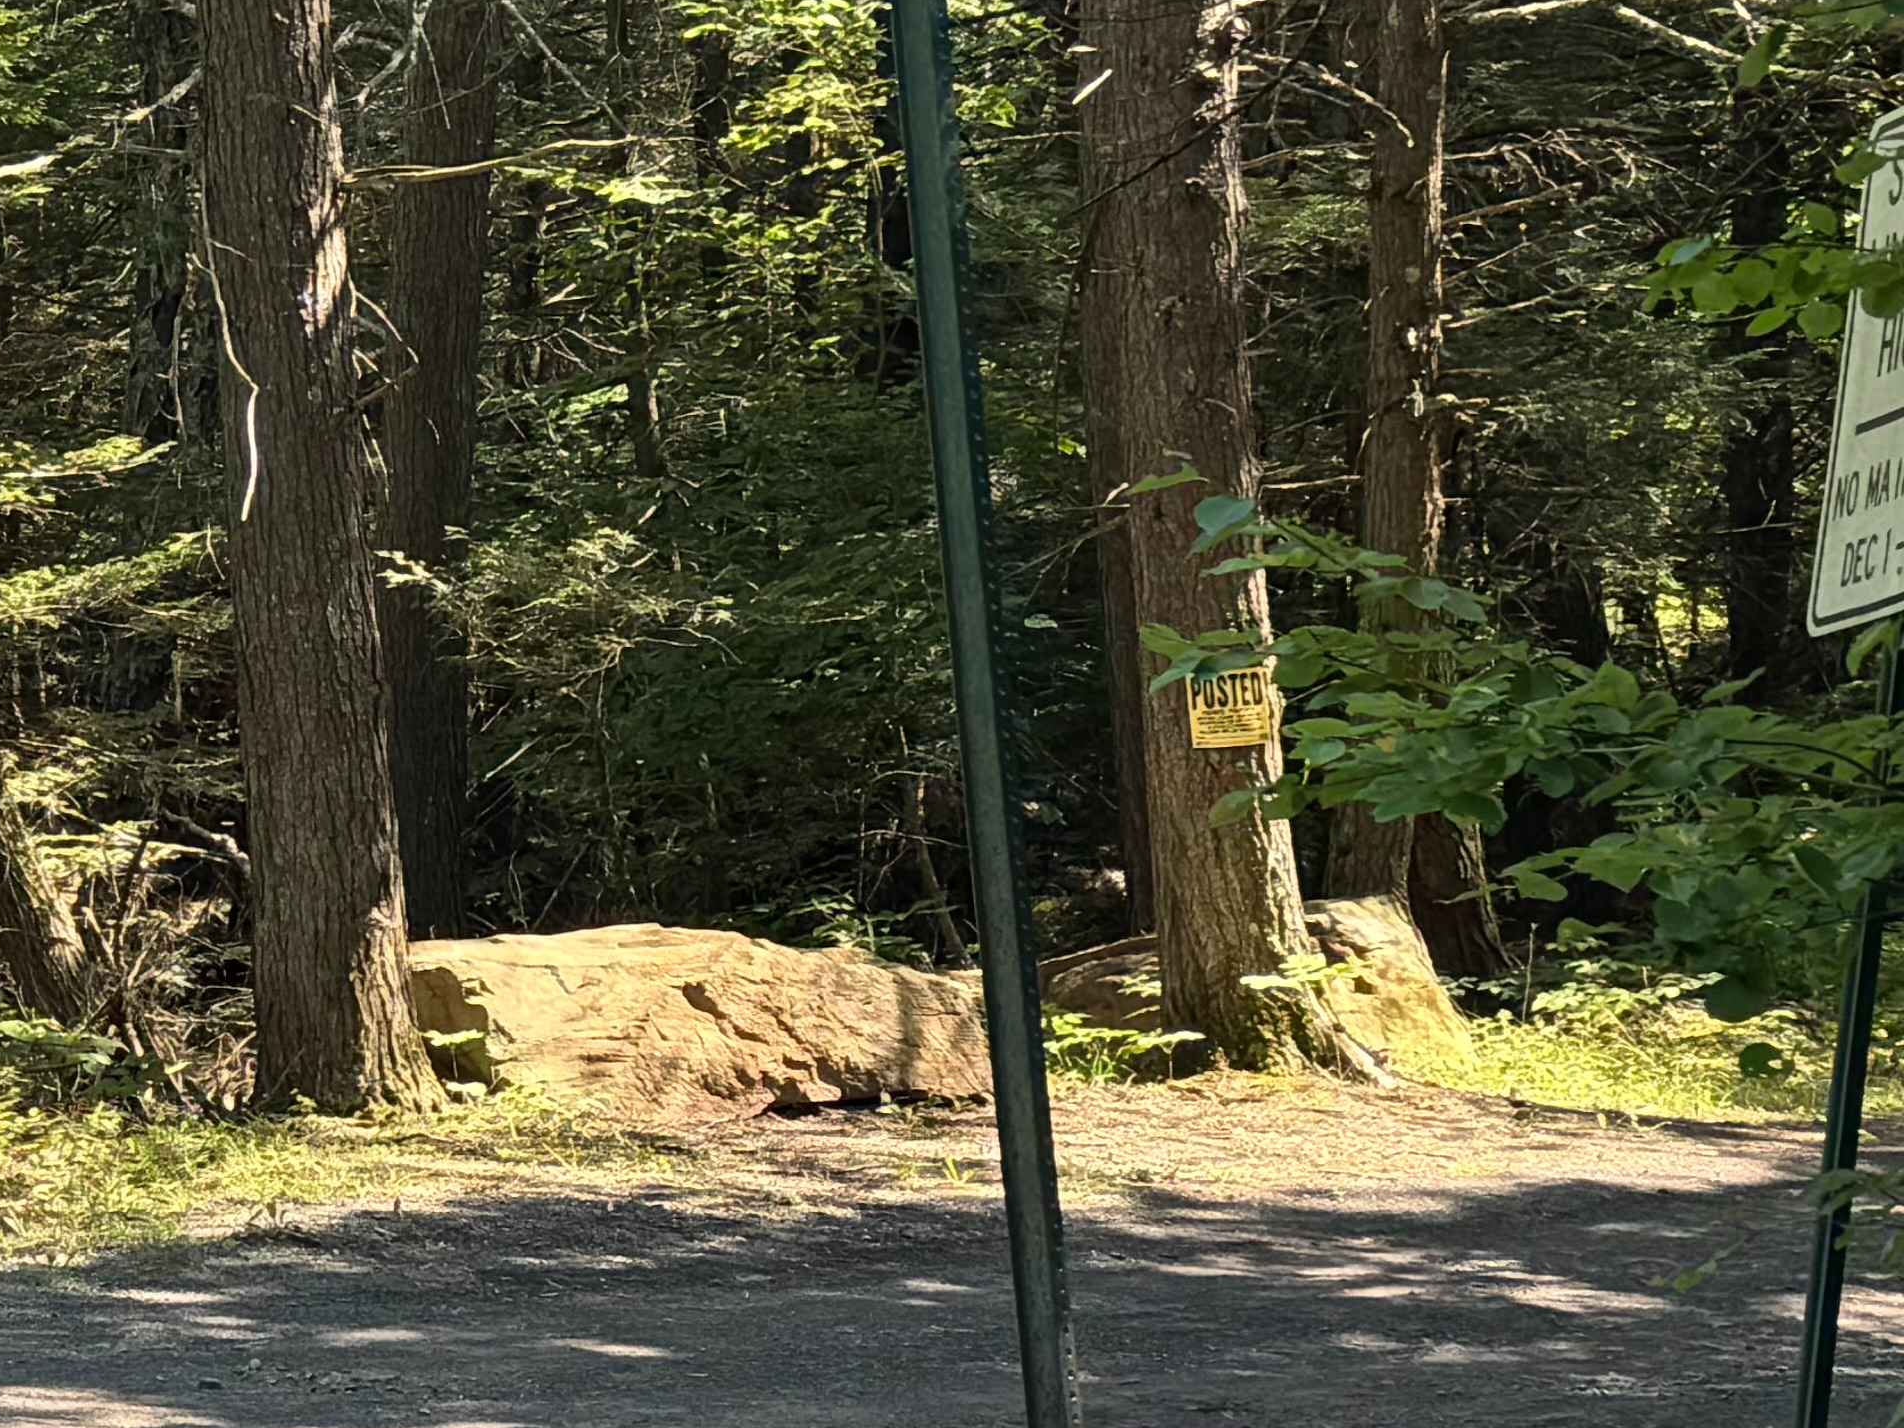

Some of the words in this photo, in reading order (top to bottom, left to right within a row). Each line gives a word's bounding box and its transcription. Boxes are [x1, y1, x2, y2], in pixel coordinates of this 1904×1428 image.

[1832, 470, 1860, 521] NO
[1864, 457, 1904, 510] MAI
[1841, 533, 1878, 588] DEC
